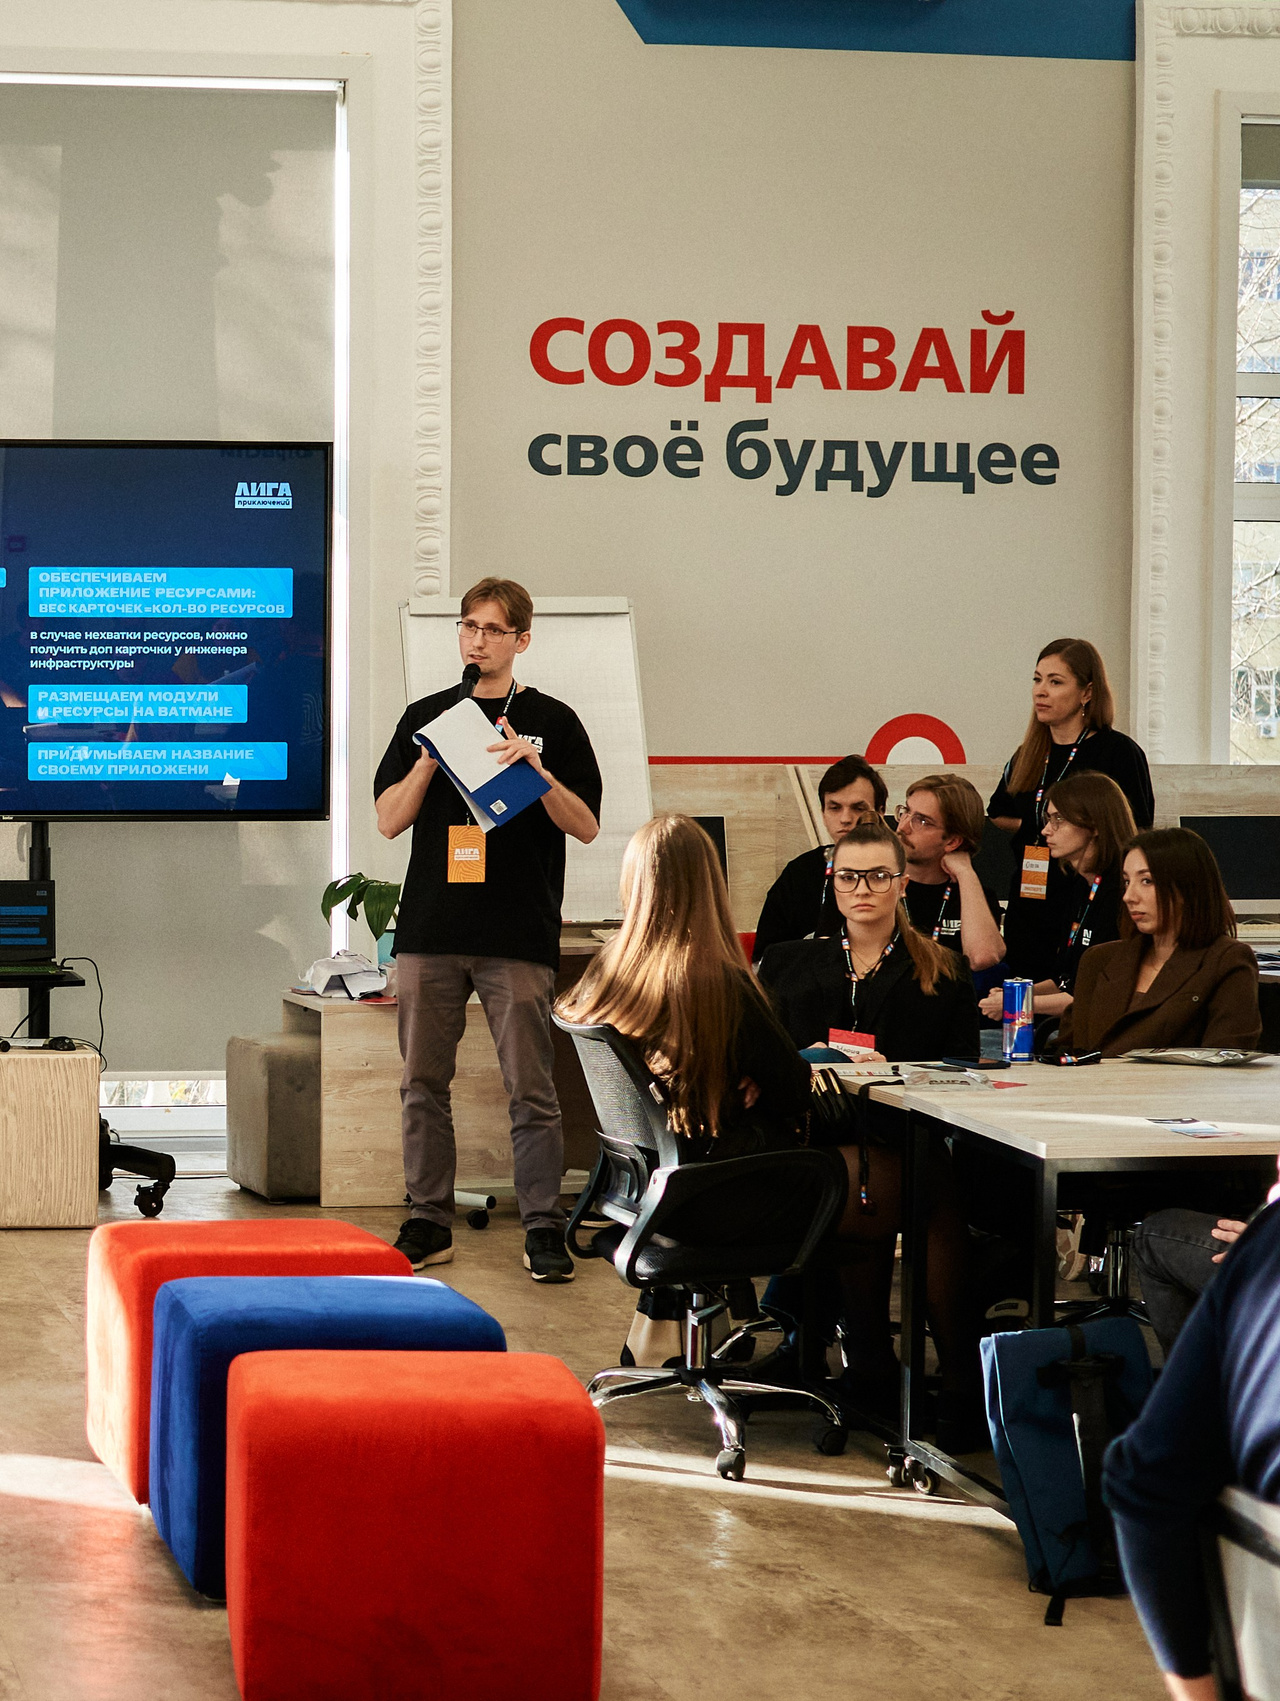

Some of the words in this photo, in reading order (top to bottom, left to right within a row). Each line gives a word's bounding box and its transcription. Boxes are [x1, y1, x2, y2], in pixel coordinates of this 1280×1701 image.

[528, 309, 1027, 404] СОЗДАВАЙ
[526, 419, 705, 480] своё
[724, 418, 1061, 498] будущее
[235, 482, 292, 496] ЛИГА
[237, 498, 291, 507] приключений
[38, 572, 167, 583] ОБЕСПЕЧИВАЕМ
[38, 587, 151, 598] ПРИЛОЖЕНИЕ
[155, 587, 257, 599] РЕСУРСАМИ:
[38, 603, 67, 613] ВЕС
[210, 604, 286, 615] РЕСУРСОВ
[30, 631, 38, 640] в
[39, 631, 82, 643] случае
[84, 631, 141, 641] нехватки
[143, 631, 204, 643] ресурсов,
[205, 631, 248, 641] можно
[30, 645, 88, 657] получить
[88, 645, 113, 657] доп
[115, 645, 172, 657] карточки
[173, 646, 182, 657] у
[184, 645, 248, 657] инженера
[30, 657, 134, 671] инфраструктуры
[38, 691, 144, 703] РАЗМЕЩАЕМ
[148, 691, 219, 703] МОДУЛИ
[38, 706, 49, 717] И
[52, 706, 129, 717] РЕСУРСЫ
[133, 706, 154, 717] НА
[158, 706, 233, 717] ВАТМАНЕ
[37, 749, 167, 761] ПРИДУМЫВАЕМ
[171, 749, 255, 760] НАЗВАНИЕ
[37, 764, 104, 775] СВОЕМУ
[107, 764, 209, 775] ПРИЛОЖЕНИ
